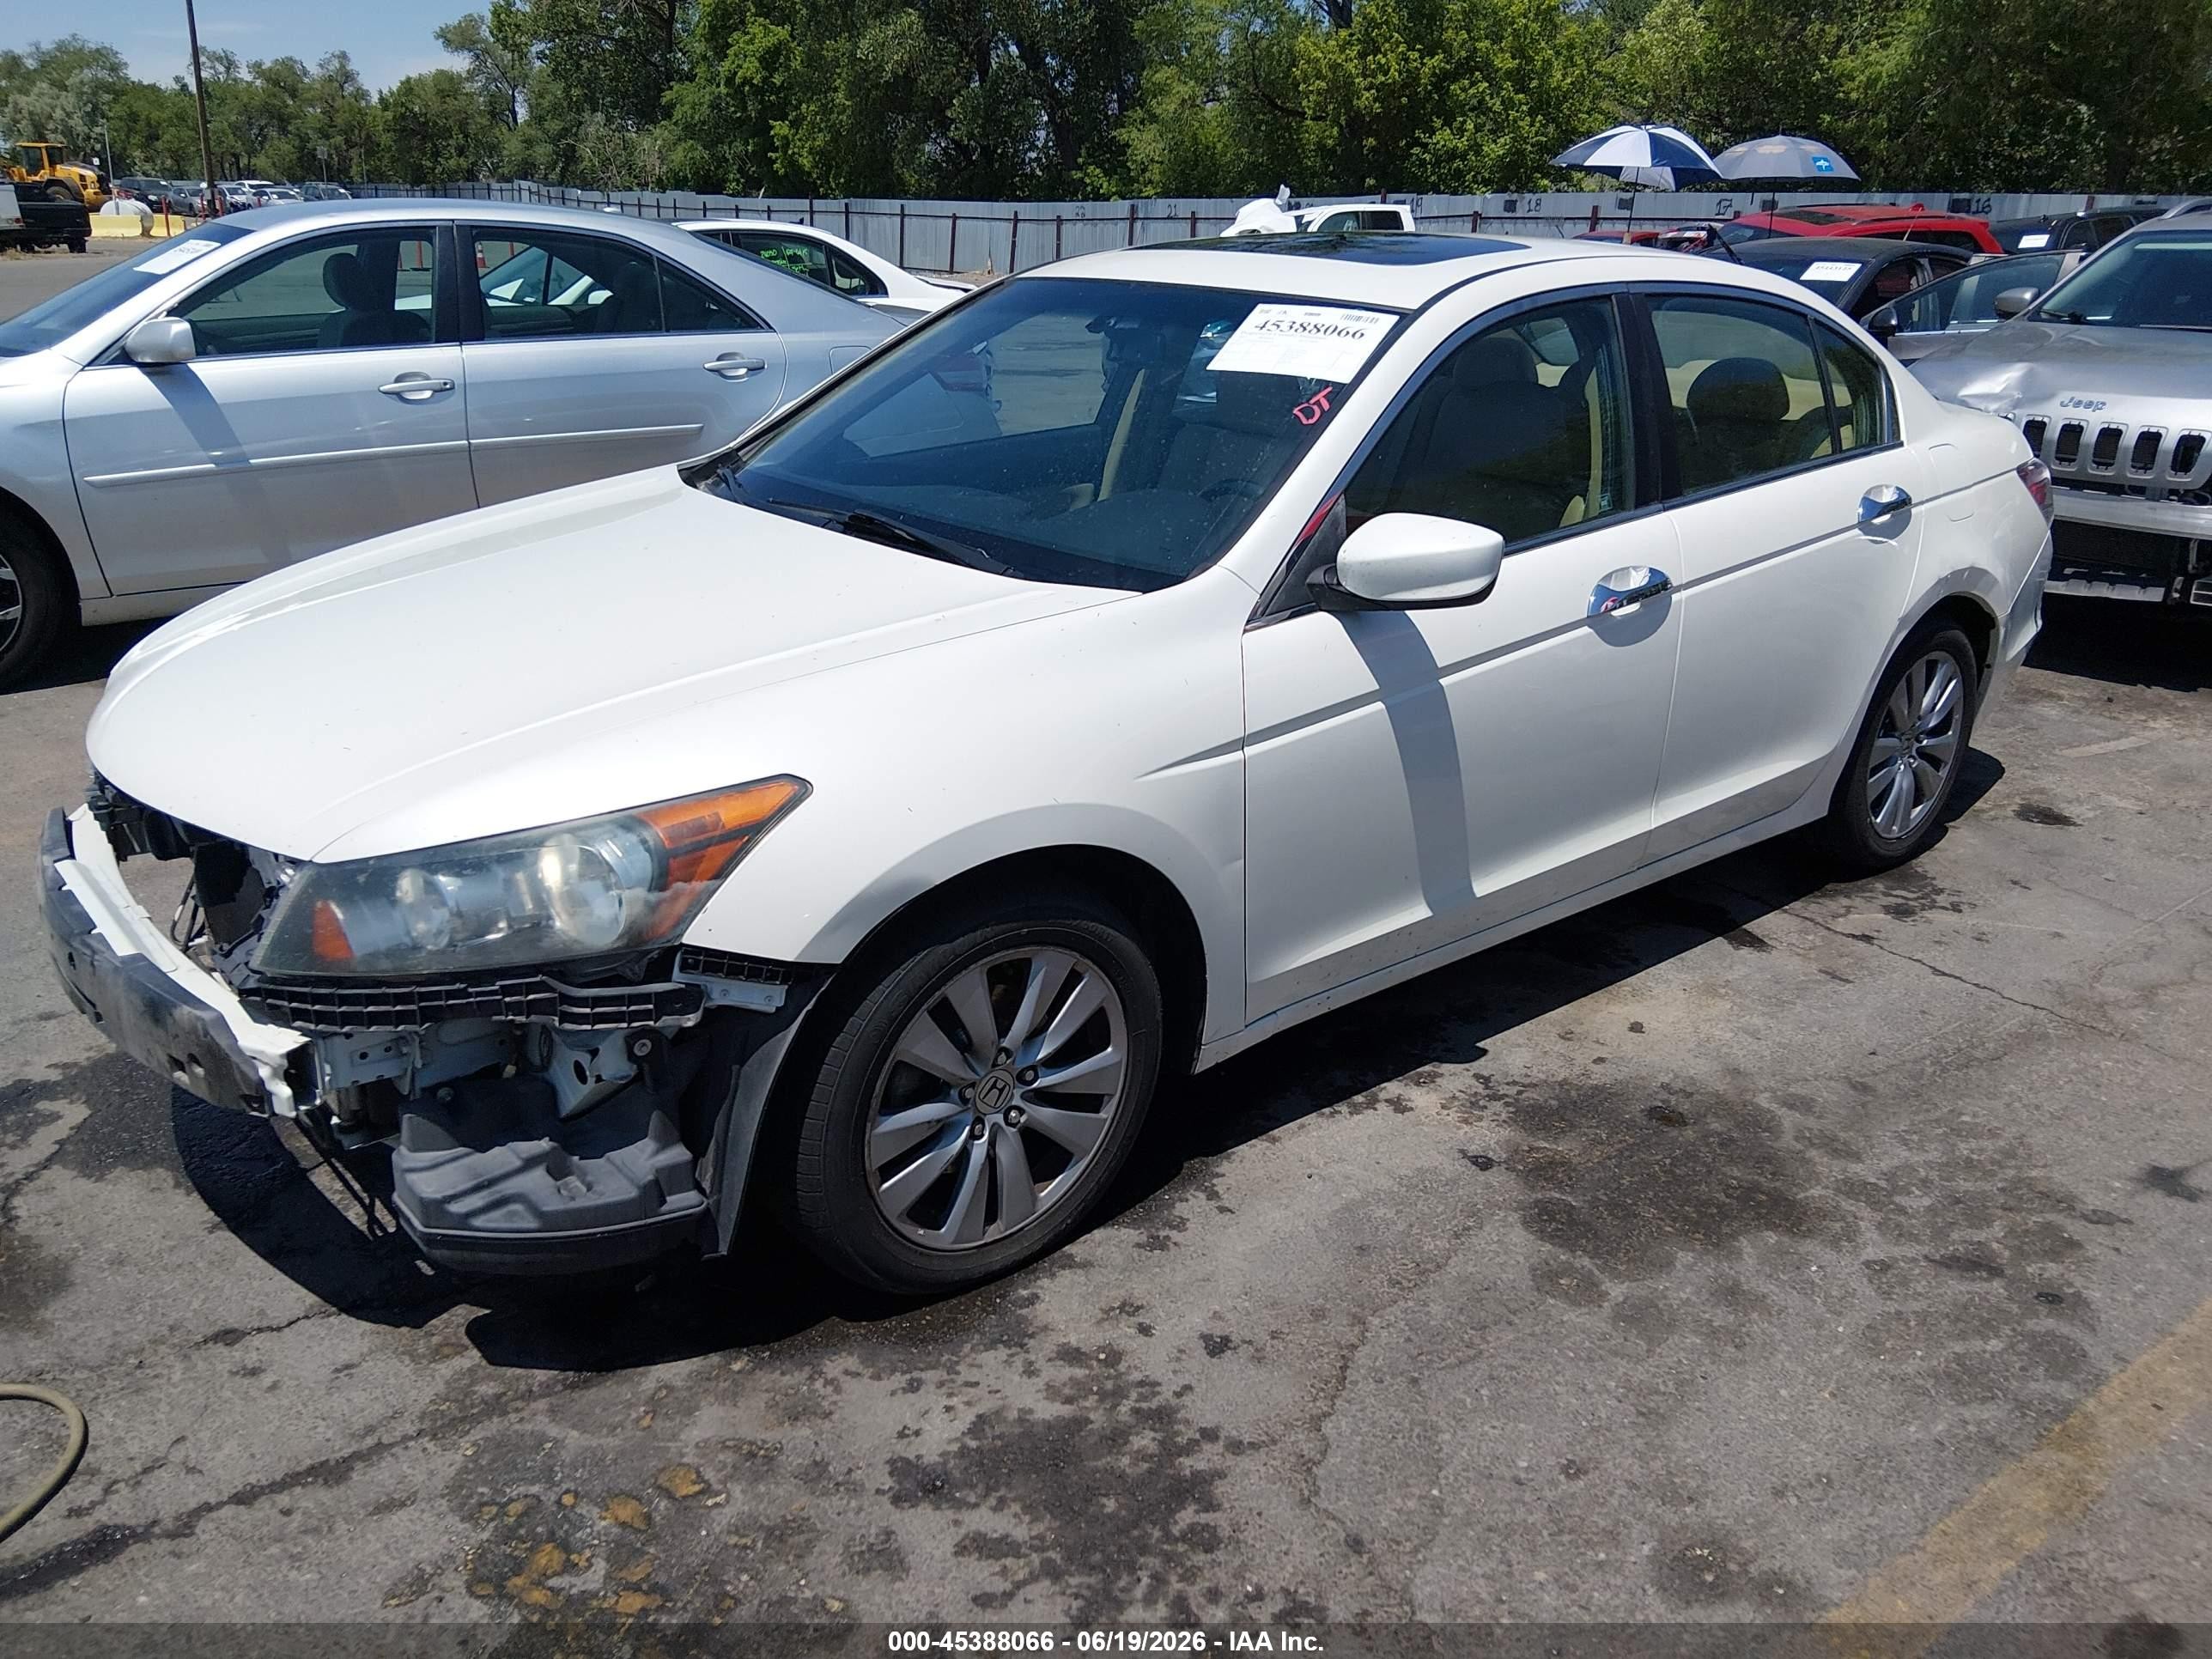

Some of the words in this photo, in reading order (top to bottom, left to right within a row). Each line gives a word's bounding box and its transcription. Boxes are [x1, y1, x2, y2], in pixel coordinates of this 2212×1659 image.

[1167, 204, 1178, 218] 21
[1526, 198, 1541, 213] 18
[1715, 198, 1733, 216] 17
[1972, 198, 1992, 215] 16
[1255, 319, 1367, 339] 45388066
[1293, 386, 1333, 425] DT
[2059, 396, 2107, 413] Jeep
